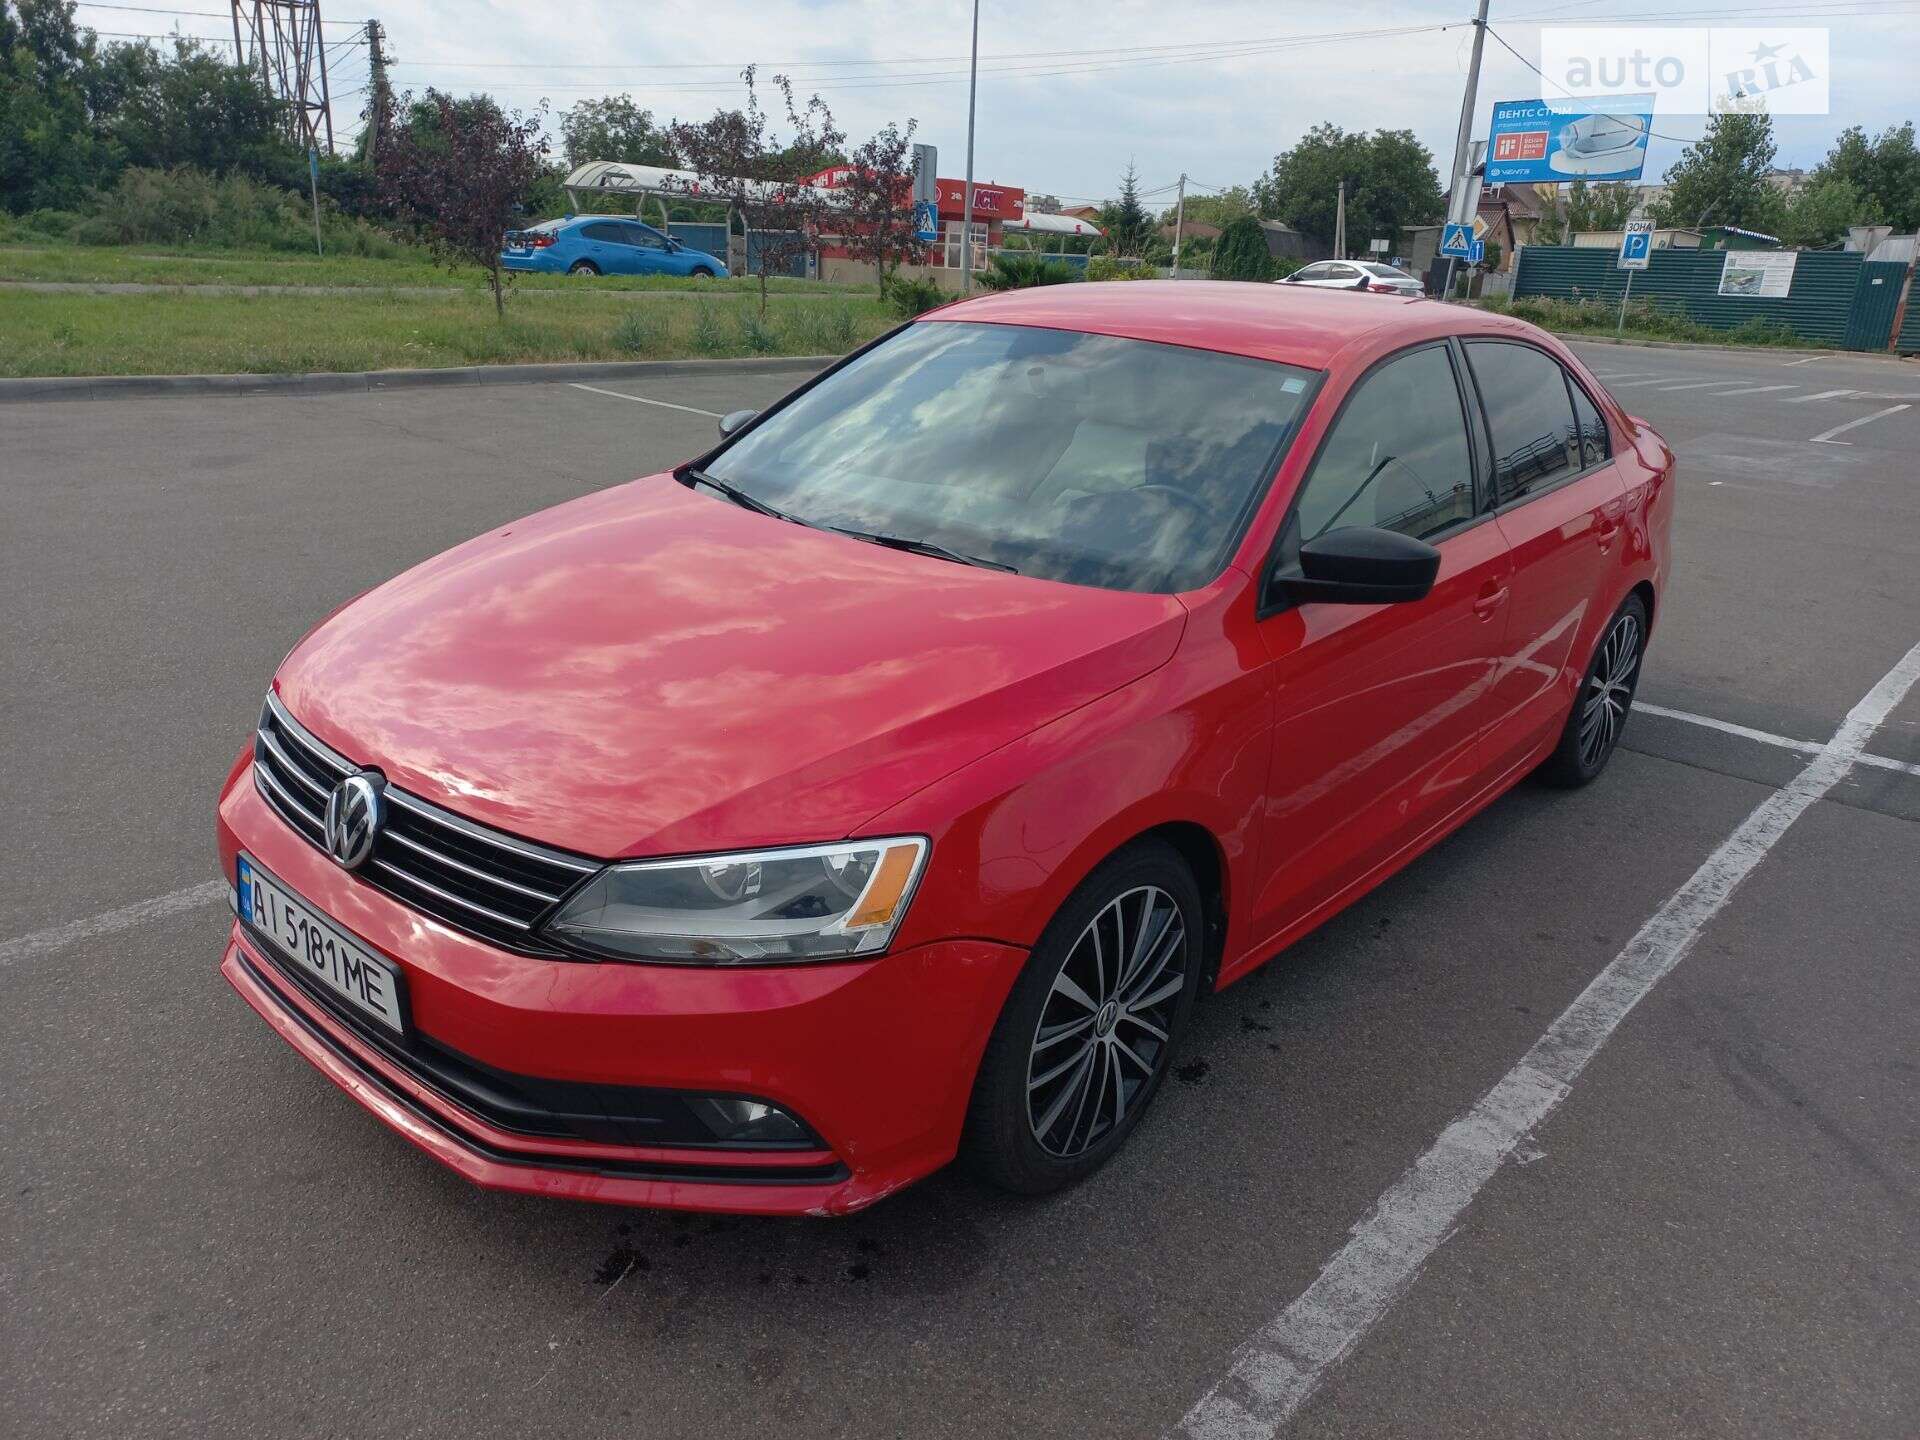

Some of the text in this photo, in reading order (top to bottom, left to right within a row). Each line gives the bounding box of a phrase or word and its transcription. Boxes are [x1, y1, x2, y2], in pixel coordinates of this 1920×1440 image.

[1498, 109, 1535, 120] ВЕНТС
[1627, 222, 1653, 232] ЗОНА
[254, 879, 277, 935] AI
